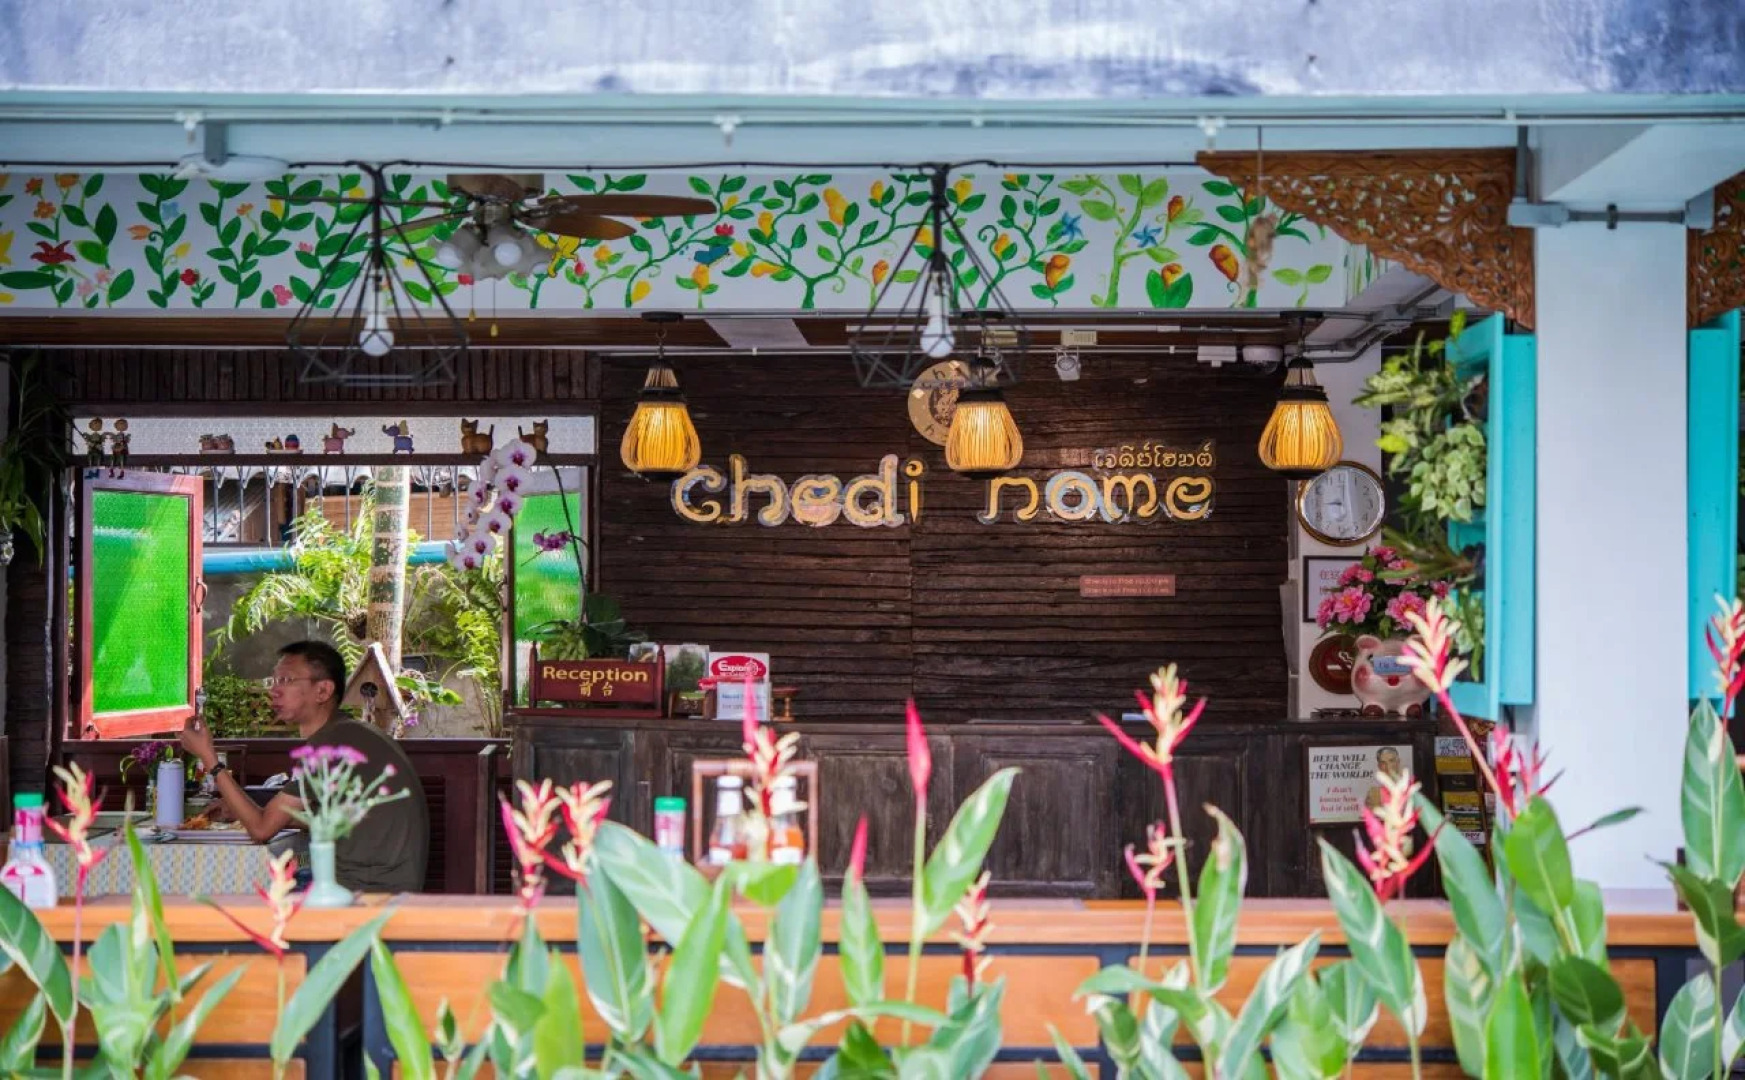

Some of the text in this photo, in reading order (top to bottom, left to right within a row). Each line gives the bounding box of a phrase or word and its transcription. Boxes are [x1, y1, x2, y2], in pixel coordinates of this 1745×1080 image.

[673, 454, 921, 525] chedi
[543, 665, 649, 684] Reception
[579, 680, 613, 697] 前台
[1312, 753, 1367, 762] BEER WILL
[1319, 762, 1361, 770] CHANGE
[1310, 771, 1331, 780] THE
